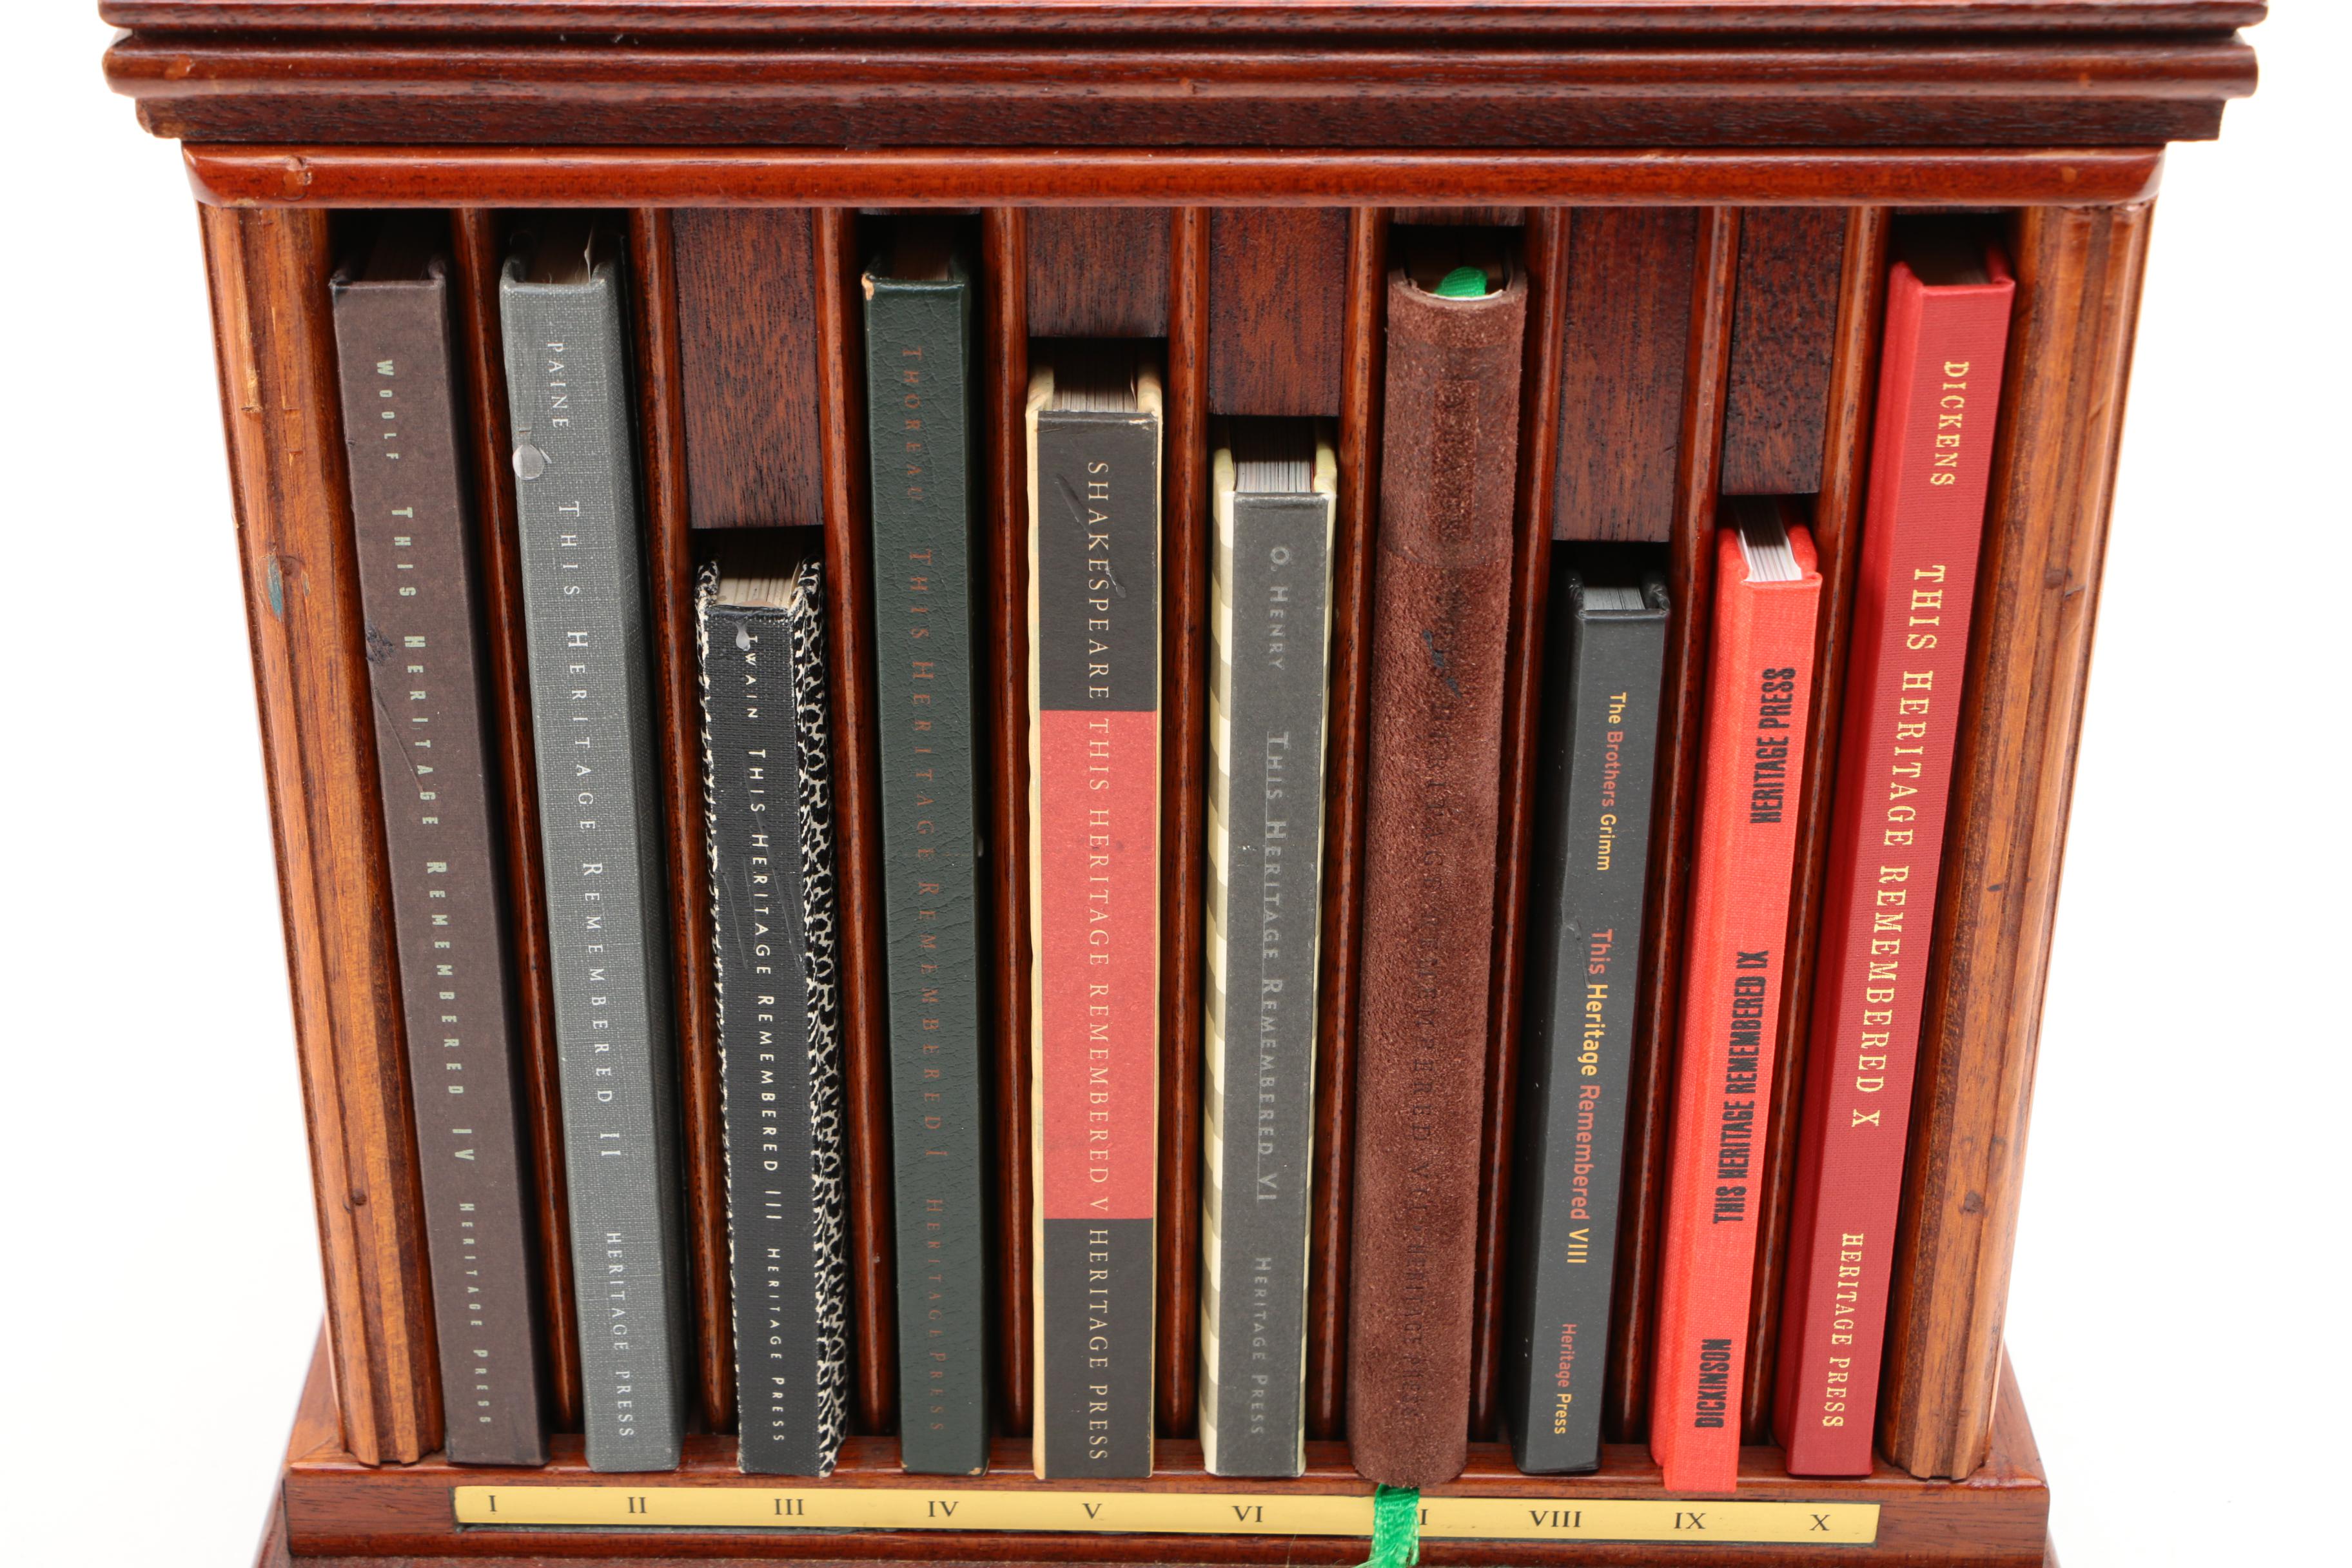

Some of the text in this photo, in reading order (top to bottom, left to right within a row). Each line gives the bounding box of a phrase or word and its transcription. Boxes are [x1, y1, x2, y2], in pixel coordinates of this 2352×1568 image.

[903, 346, 923, 501] THOREAU
[909, 550, 932, 639] THIS
[912, 661, 934, 859] HERITAGE
[377, 360, 491, 1422] WOOLF THIS HERITAGE REMEMBERED IV HERITAGE PRESS
[547, 342, 634, 1436] PAINE THIS HERITAGE REMEMBERED II HERITAGE PRESS
[744, 635, 785, 1442] TWAIN THIS HERITAGE REMEMBERED III HERITAGE PRESS
[918, 882, 941, 1129] REMEMBERED
[1088, 461, 1110, 1459] SHAKESPEARE THIS HERITAGE REMEMBERED V HERITAGE PRESS
[1251, 546, 1289, 1435] O. HENRY THIS HERITAGE REMEMBERED VI HERITAGE PRESS
[1554, 692, 1627, 1435] The Brothers Grimm This Heritage Remembered VIII Heritage Press
[1695, 667, 1797, 1427] DICKINSON THIS HERITAGE REMEMBERED IX HERITAGE PRESS
[1822, 361, 1969, 1427] DICKENS THIS HERITAGE REMEMBERED X HERITAGE PRESS
[488, 1495, 1830, 1531] I II III IV V VI VIII IX X
[926, 1199, 946, 1337] HERITAGE
[930, 1352, 946, 1431] PRESS
